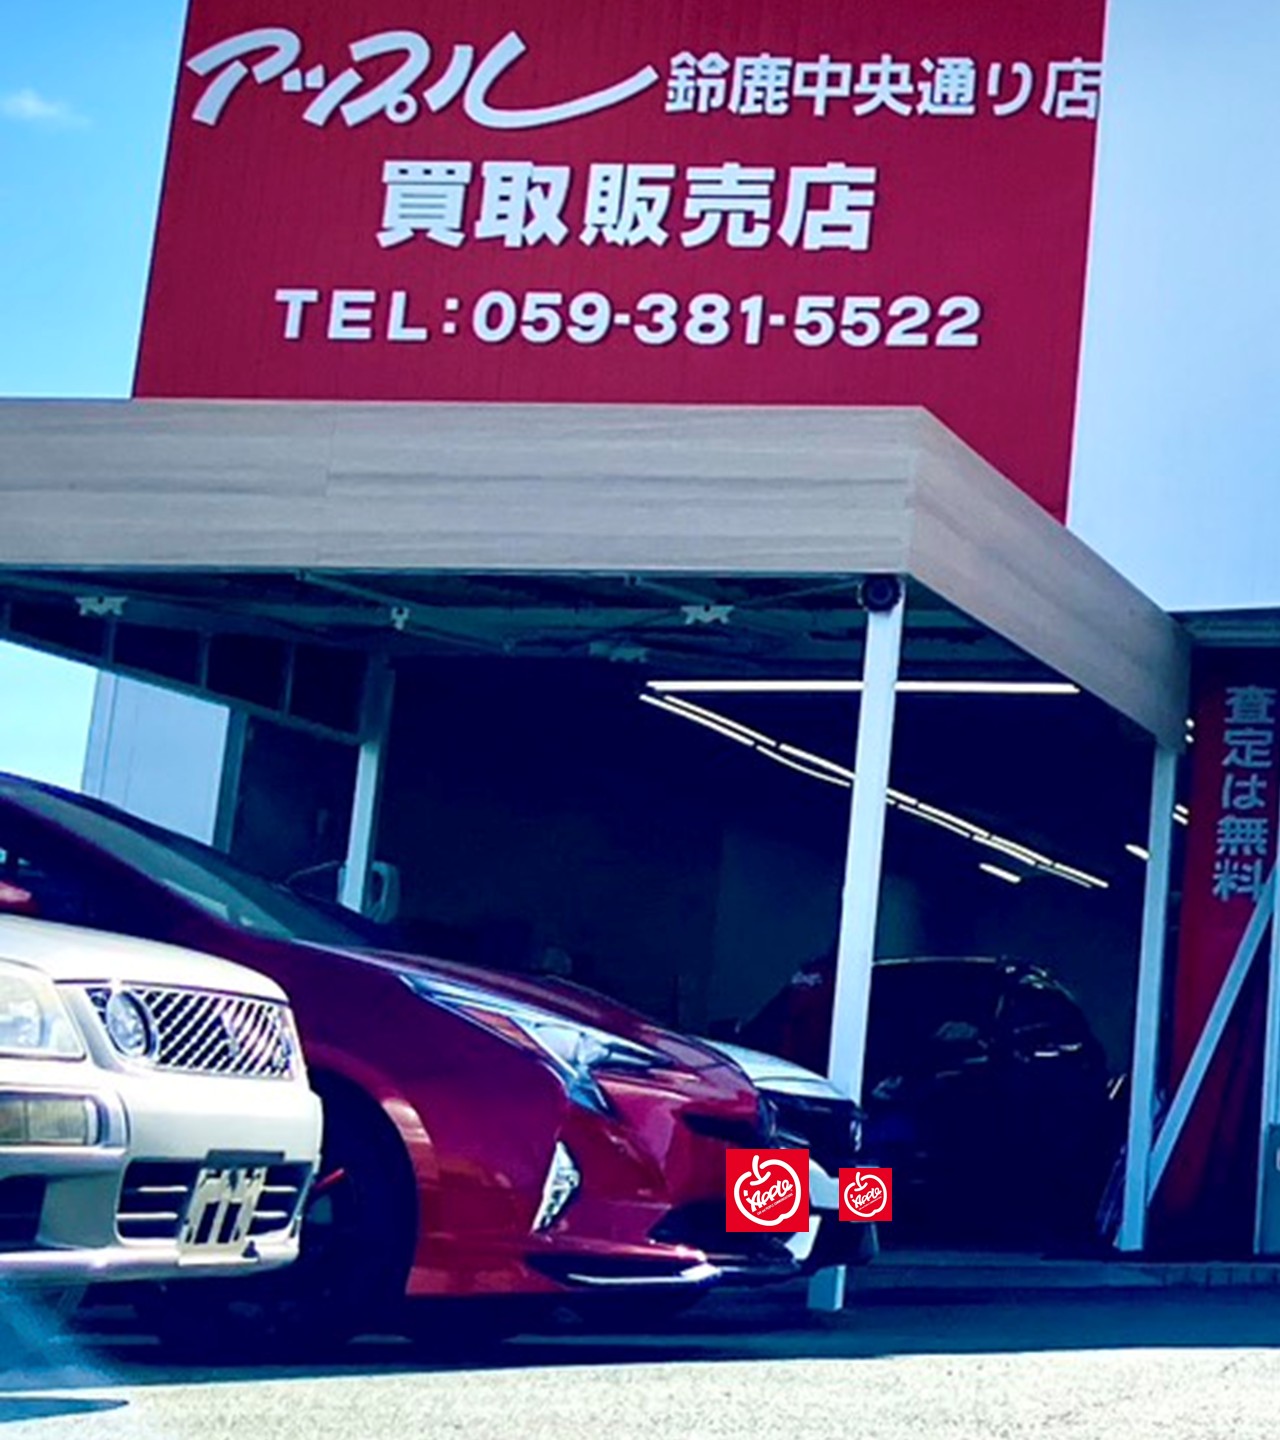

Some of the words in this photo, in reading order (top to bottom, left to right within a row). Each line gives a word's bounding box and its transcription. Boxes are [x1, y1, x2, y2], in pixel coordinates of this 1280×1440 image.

[186, 26, 660, 129] アップル
[664, 50, 1101, 120] 鈴鹿中央通り店
[376, 161, 876, 251] 買取販売店
[1213, 685, 1277, 901] 査定は無料
